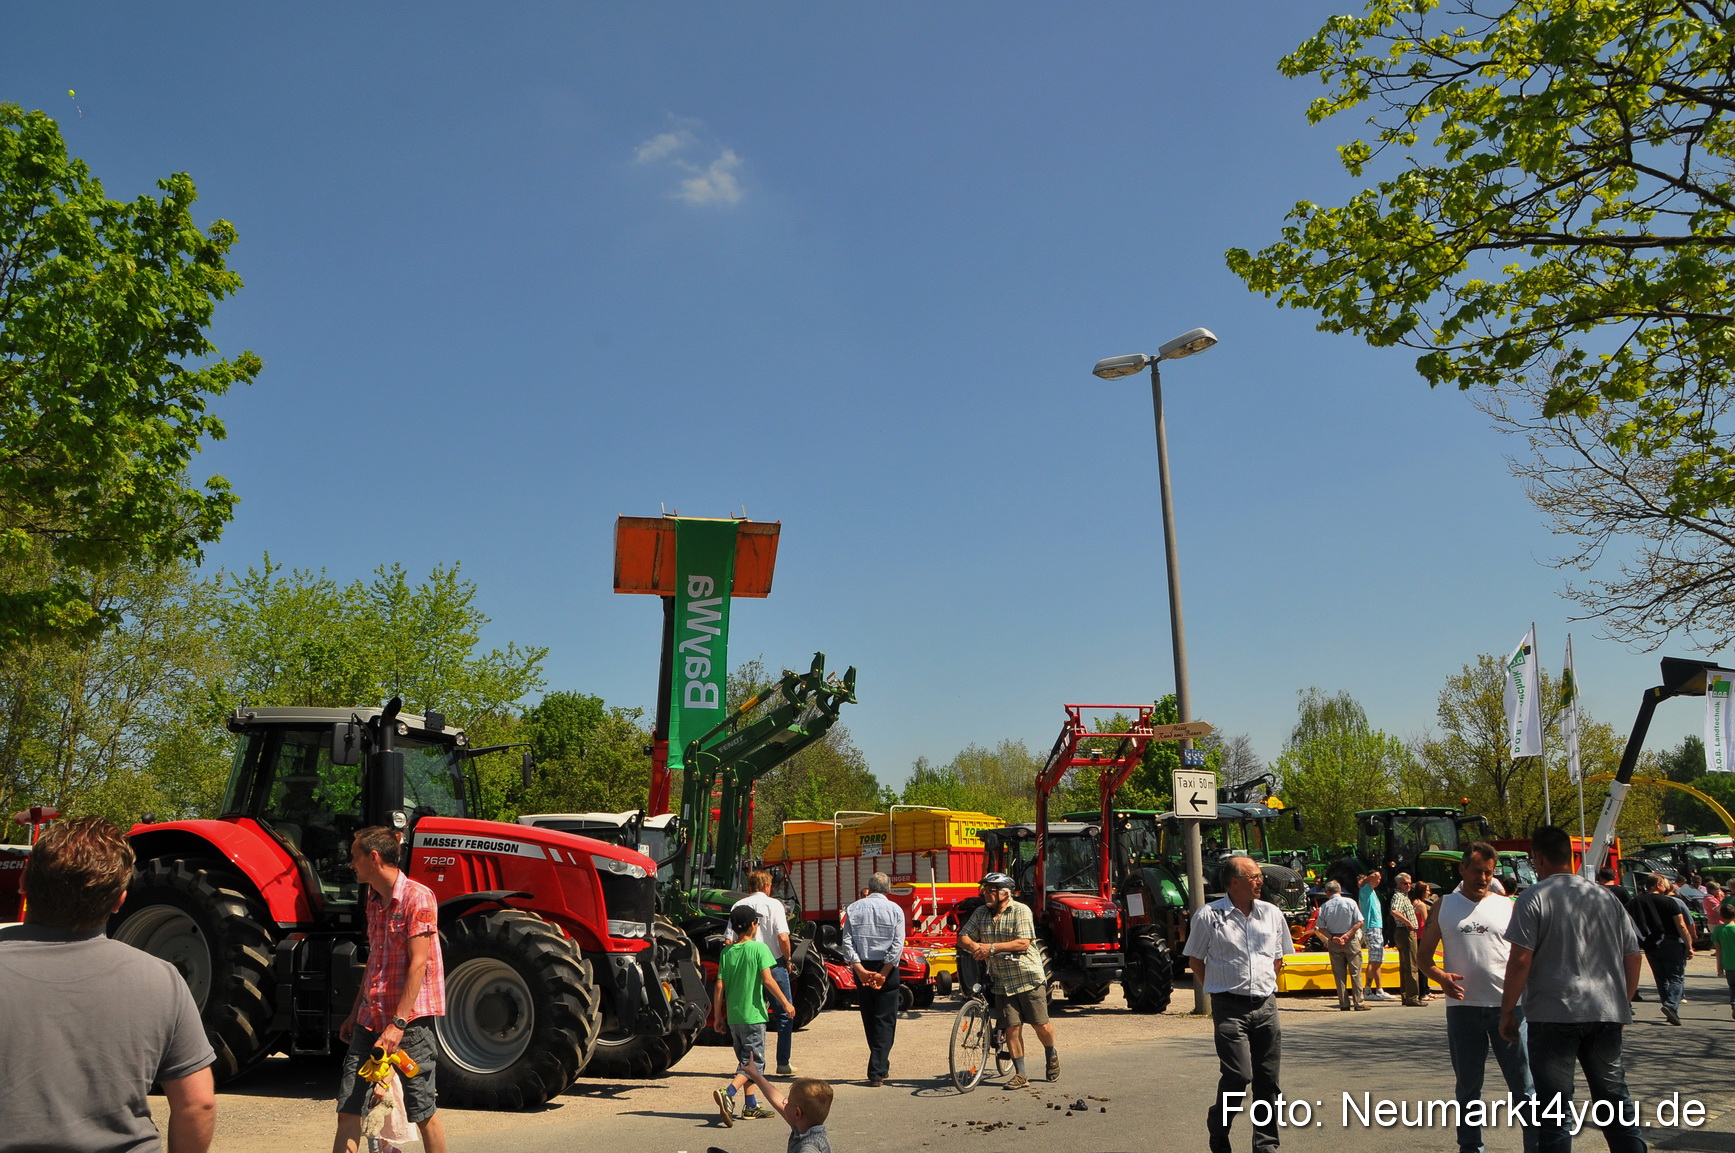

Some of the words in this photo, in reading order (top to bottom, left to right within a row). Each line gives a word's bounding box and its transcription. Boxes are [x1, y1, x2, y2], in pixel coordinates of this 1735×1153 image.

[1713, 701, 1721, 747] Landtechnik
[718, 735, 744, 753] FENDT
[1177, 777, 1196, 788] Taxi
[422, 837, 464, 848] MASSEY
[465, 839, 519, 853] FERGUSON
[859, 833, 888, 845] TORRO
[422, 856, 456, 866] 7620
